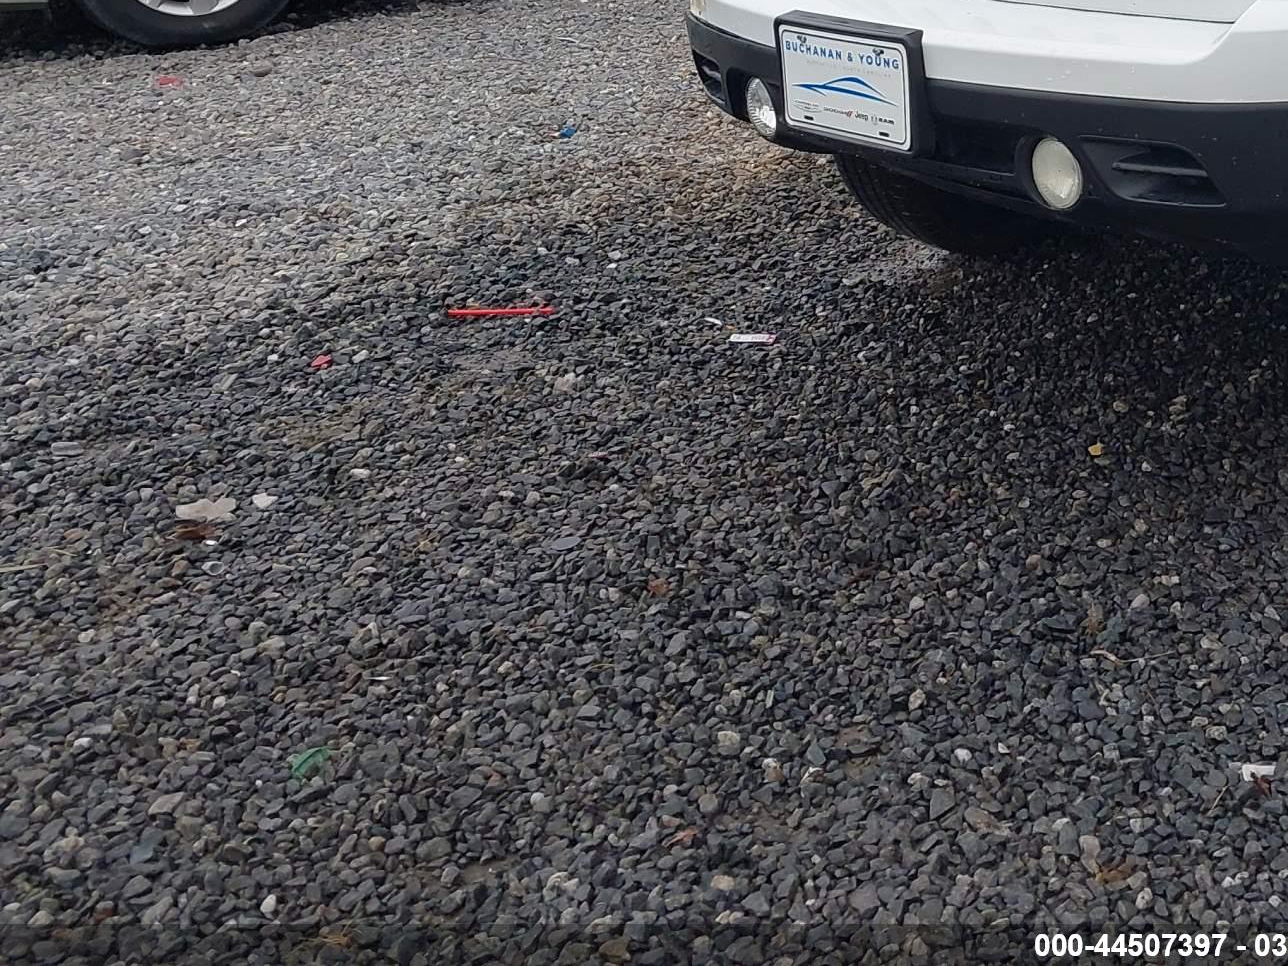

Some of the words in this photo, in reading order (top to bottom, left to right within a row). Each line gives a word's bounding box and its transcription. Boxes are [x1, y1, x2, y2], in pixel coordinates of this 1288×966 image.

[785, 40, 842, 60] BUCHANAN
[847, 52, 853, 62] &
[859, 54, 900, 69] YOUNG
